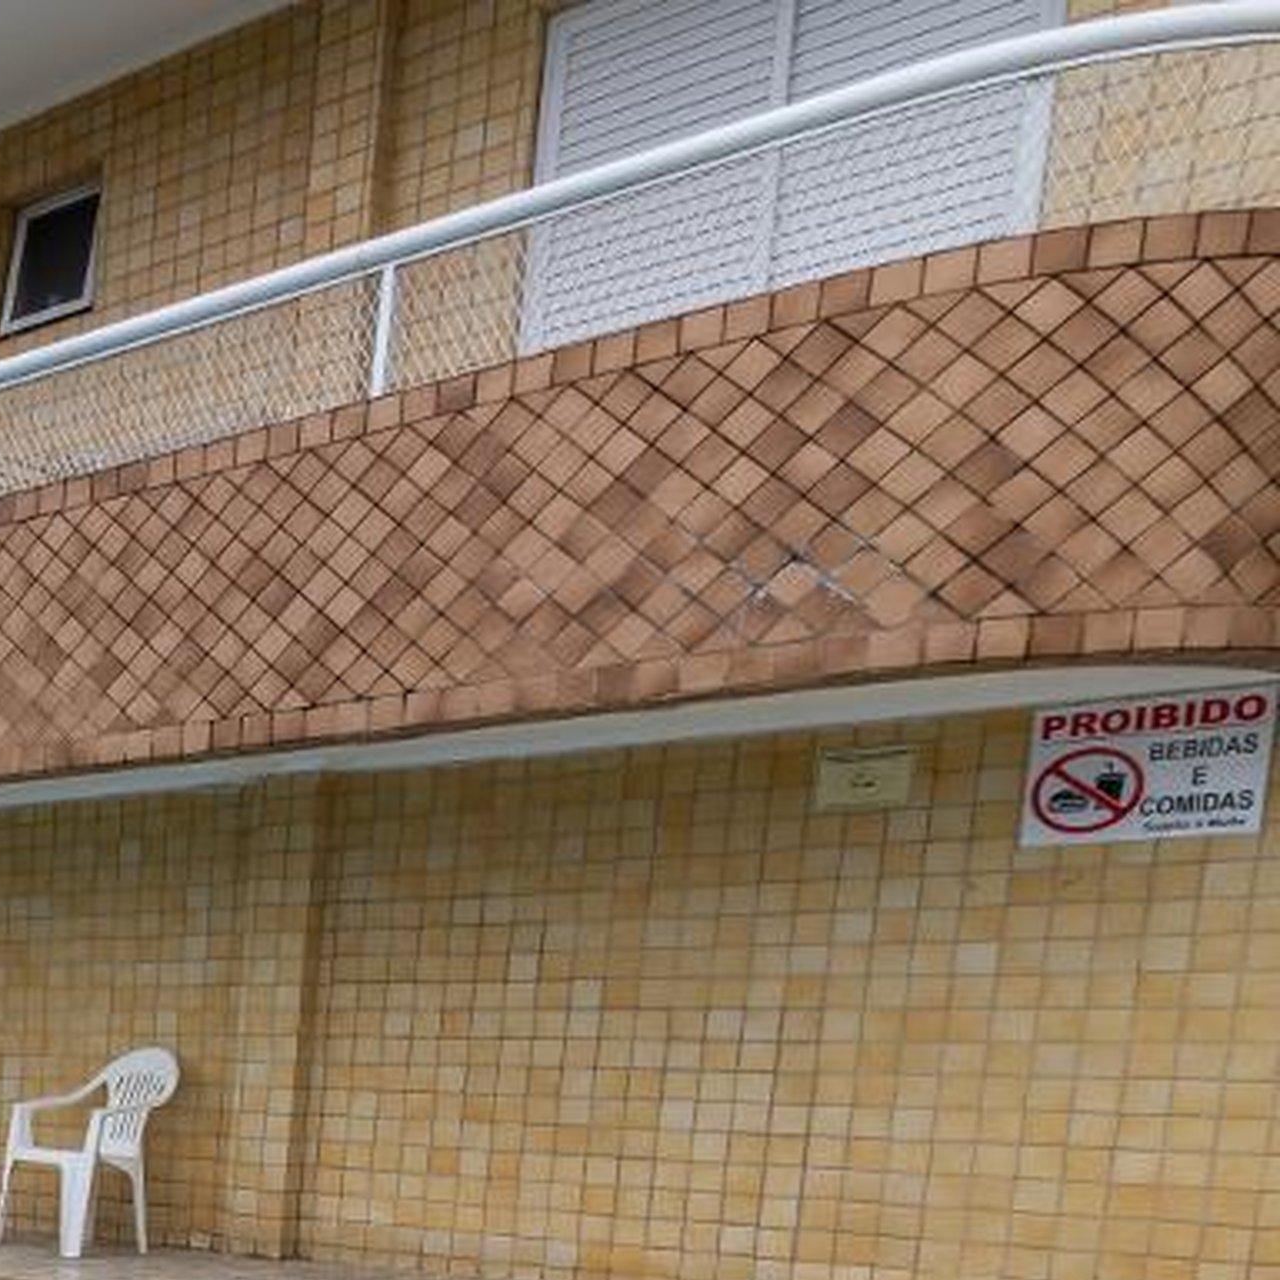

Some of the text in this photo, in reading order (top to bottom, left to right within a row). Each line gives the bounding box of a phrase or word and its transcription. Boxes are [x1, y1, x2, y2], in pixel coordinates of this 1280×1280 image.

[1042, 695, 1267, 740] PROIBIDO
[1148, 733, 1259, 762] BEBIDAS
[1192, 766, 1207, 787] E
[1140, 789, 1254, 816] COMIDAS
